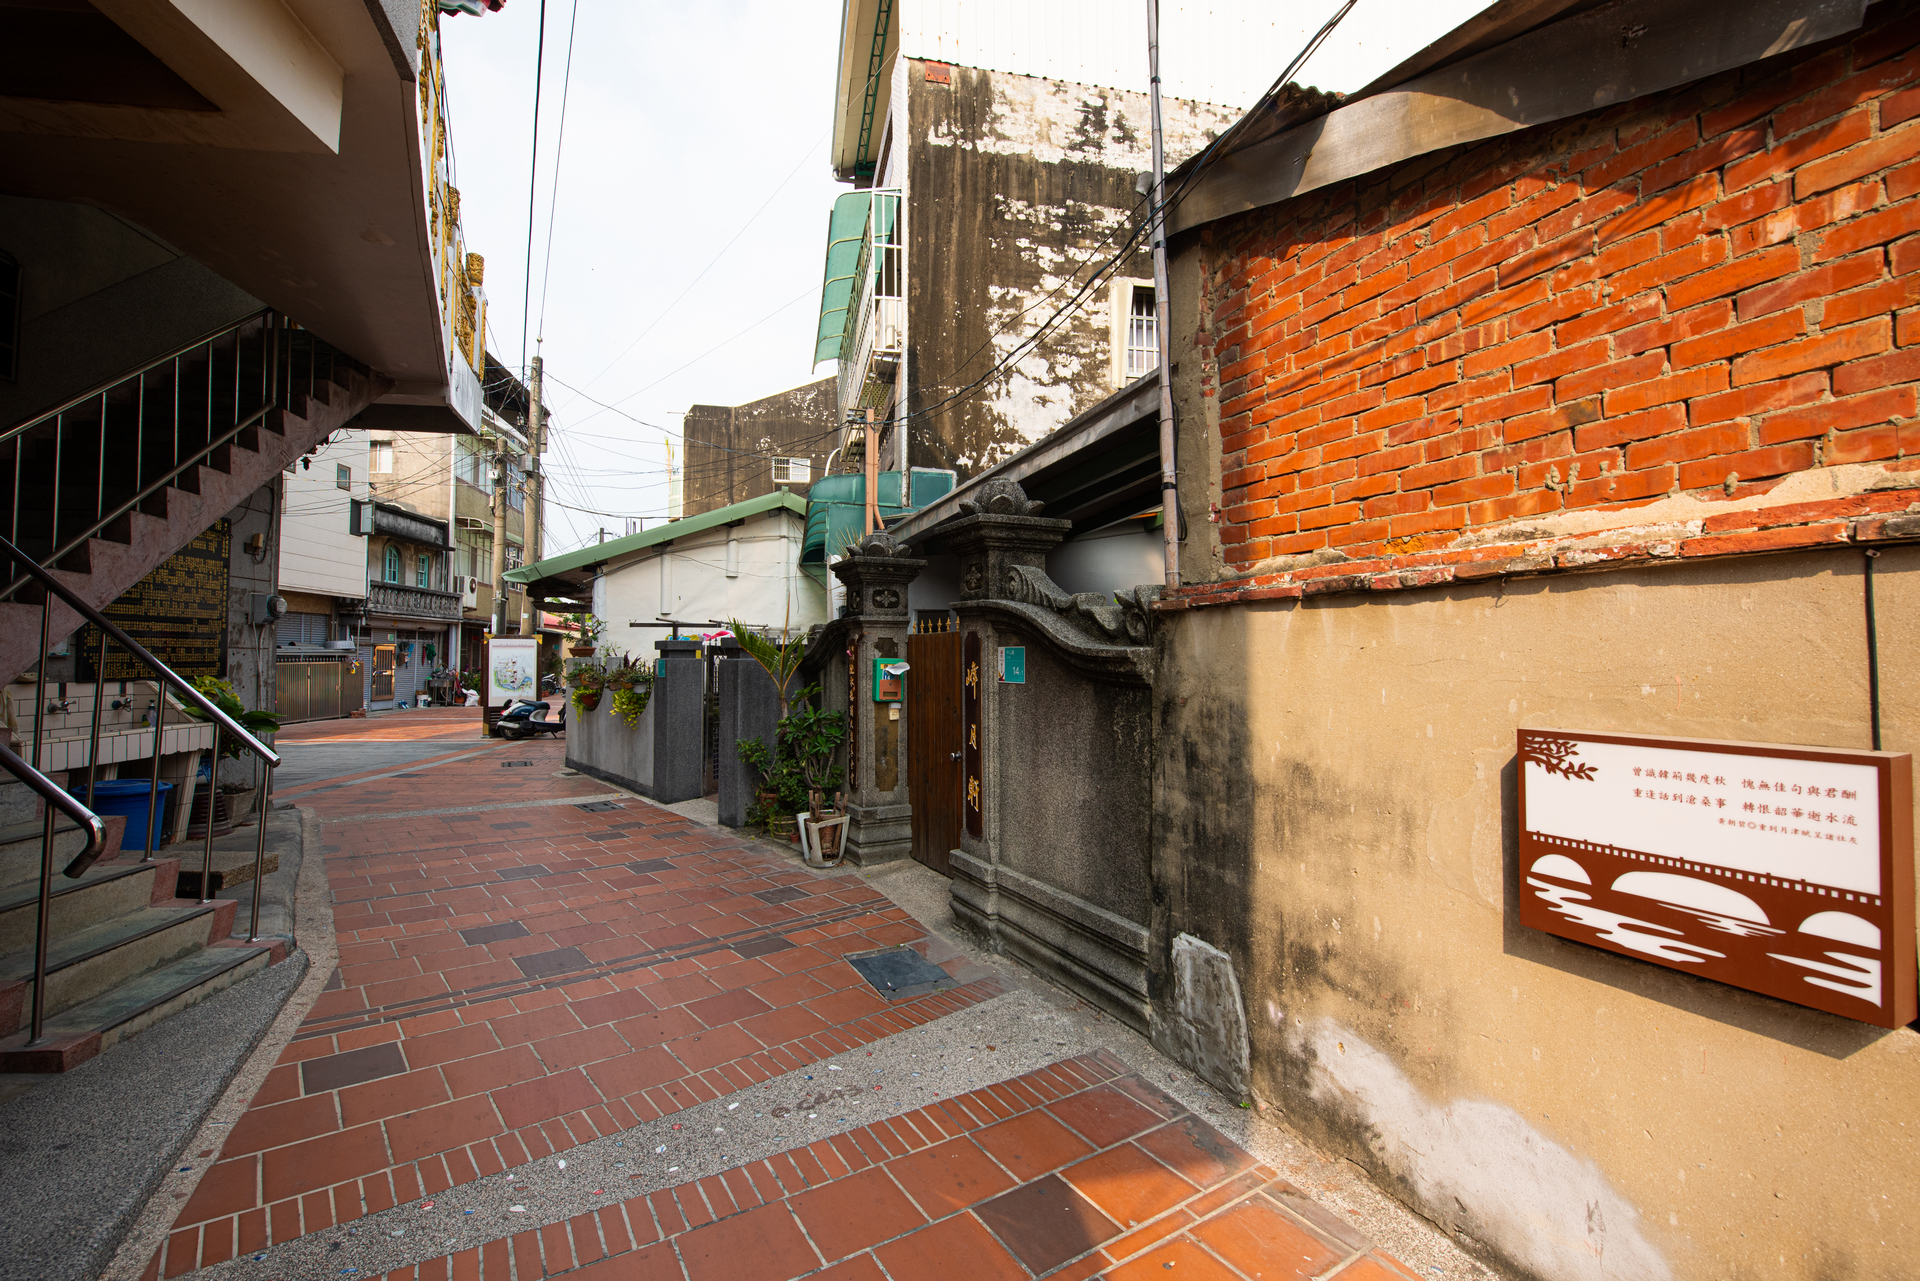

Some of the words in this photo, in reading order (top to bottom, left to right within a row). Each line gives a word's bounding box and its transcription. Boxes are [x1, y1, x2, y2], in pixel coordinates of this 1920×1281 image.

[1741, 801, 1858, 827] 轉恨韶華逝水流
